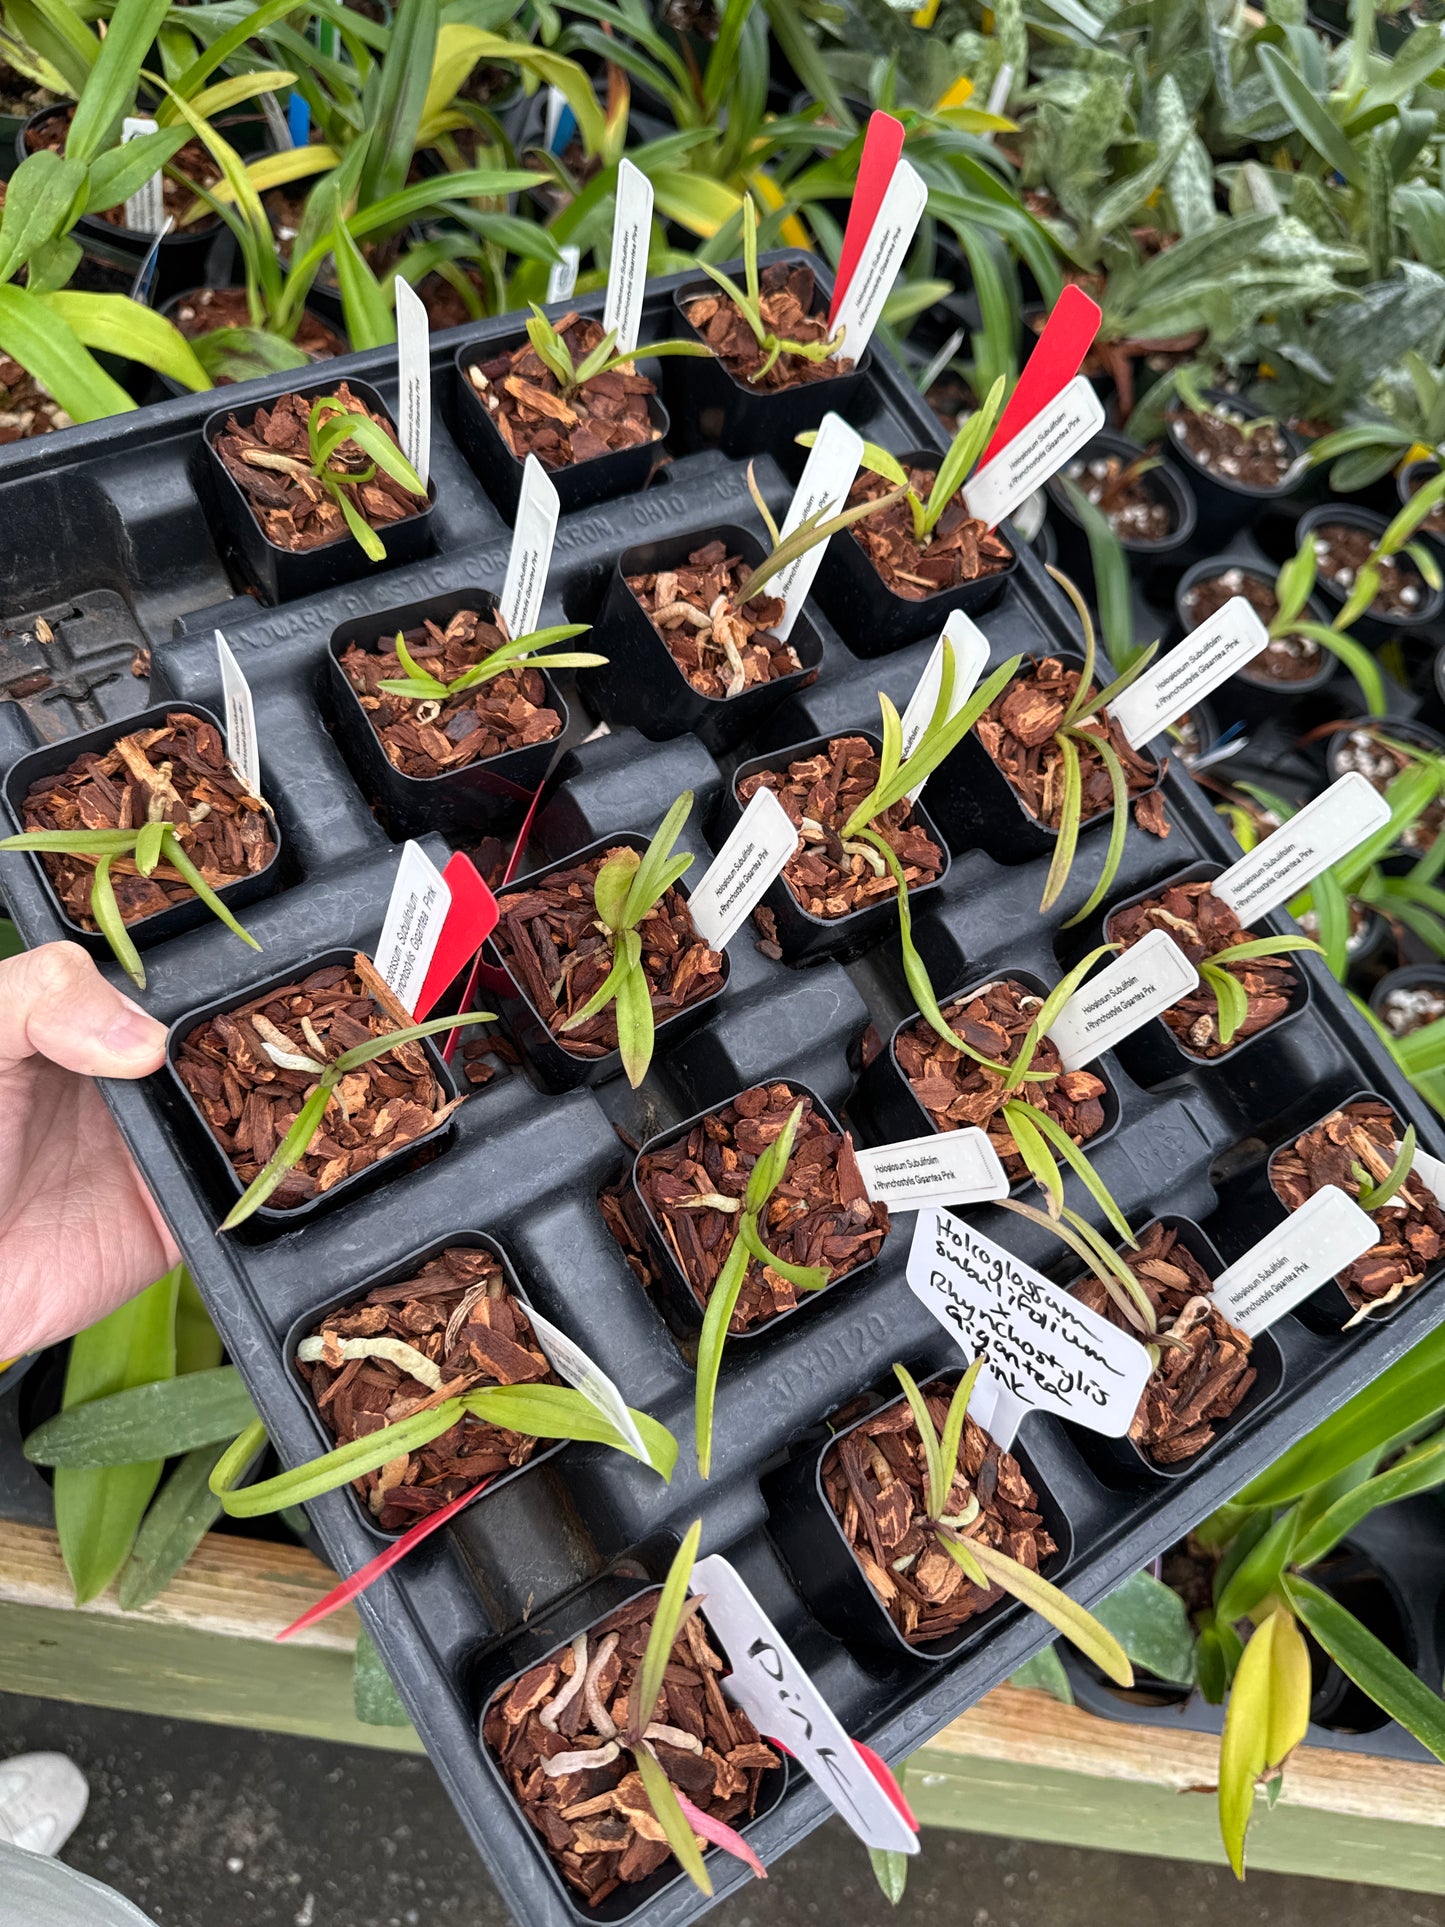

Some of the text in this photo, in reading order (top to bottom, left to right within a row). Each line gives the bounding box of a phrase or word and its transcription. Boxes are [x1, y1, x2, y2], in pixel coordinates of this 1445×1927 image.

[893, 227, 901, 243] Pink
[1068, 416, 1080, 430] Pink
[818, 491, 829, 510] Pink
[1159, 672, 1199, 705] Rhynchostylis
[1198, 650, 1226, 673] Gigantea
[1224, 639, 1240, 652] Pink
[720, 881, 746, 913] Rhynchostylis
[743, 860, 761, 883] Gigantea
[758, 848, 769, 862] Pink
[1236, 877, 1276, 908] Rhynchostylis
[1274, 858, 1301, 879] Gigantea
[1299, 848, 1314, 860] Pink
[397, 893, 417, 945] Subulifolium
[410, 911, 429, 950] Gigantea
[423, 886, 437, 910] Pink
[1087, 1006, 1122, 1029] Rhynchostylis
[1120, 992, 1145, 1009] Gigantea
[1142, 984, 1156, 995] Pink
[877, 1177, 915, 1189] Rhynchostylis
[915, 1174, 942, 1184] Gigantea
[941, 1170, 956, 1180] Pink
[1236, 1290, 1274, 1319] Rhynchostylis
[1271, 1272, 1298, 1293] Gigantea
[1294, 1262, 1310, 1275] Pink
